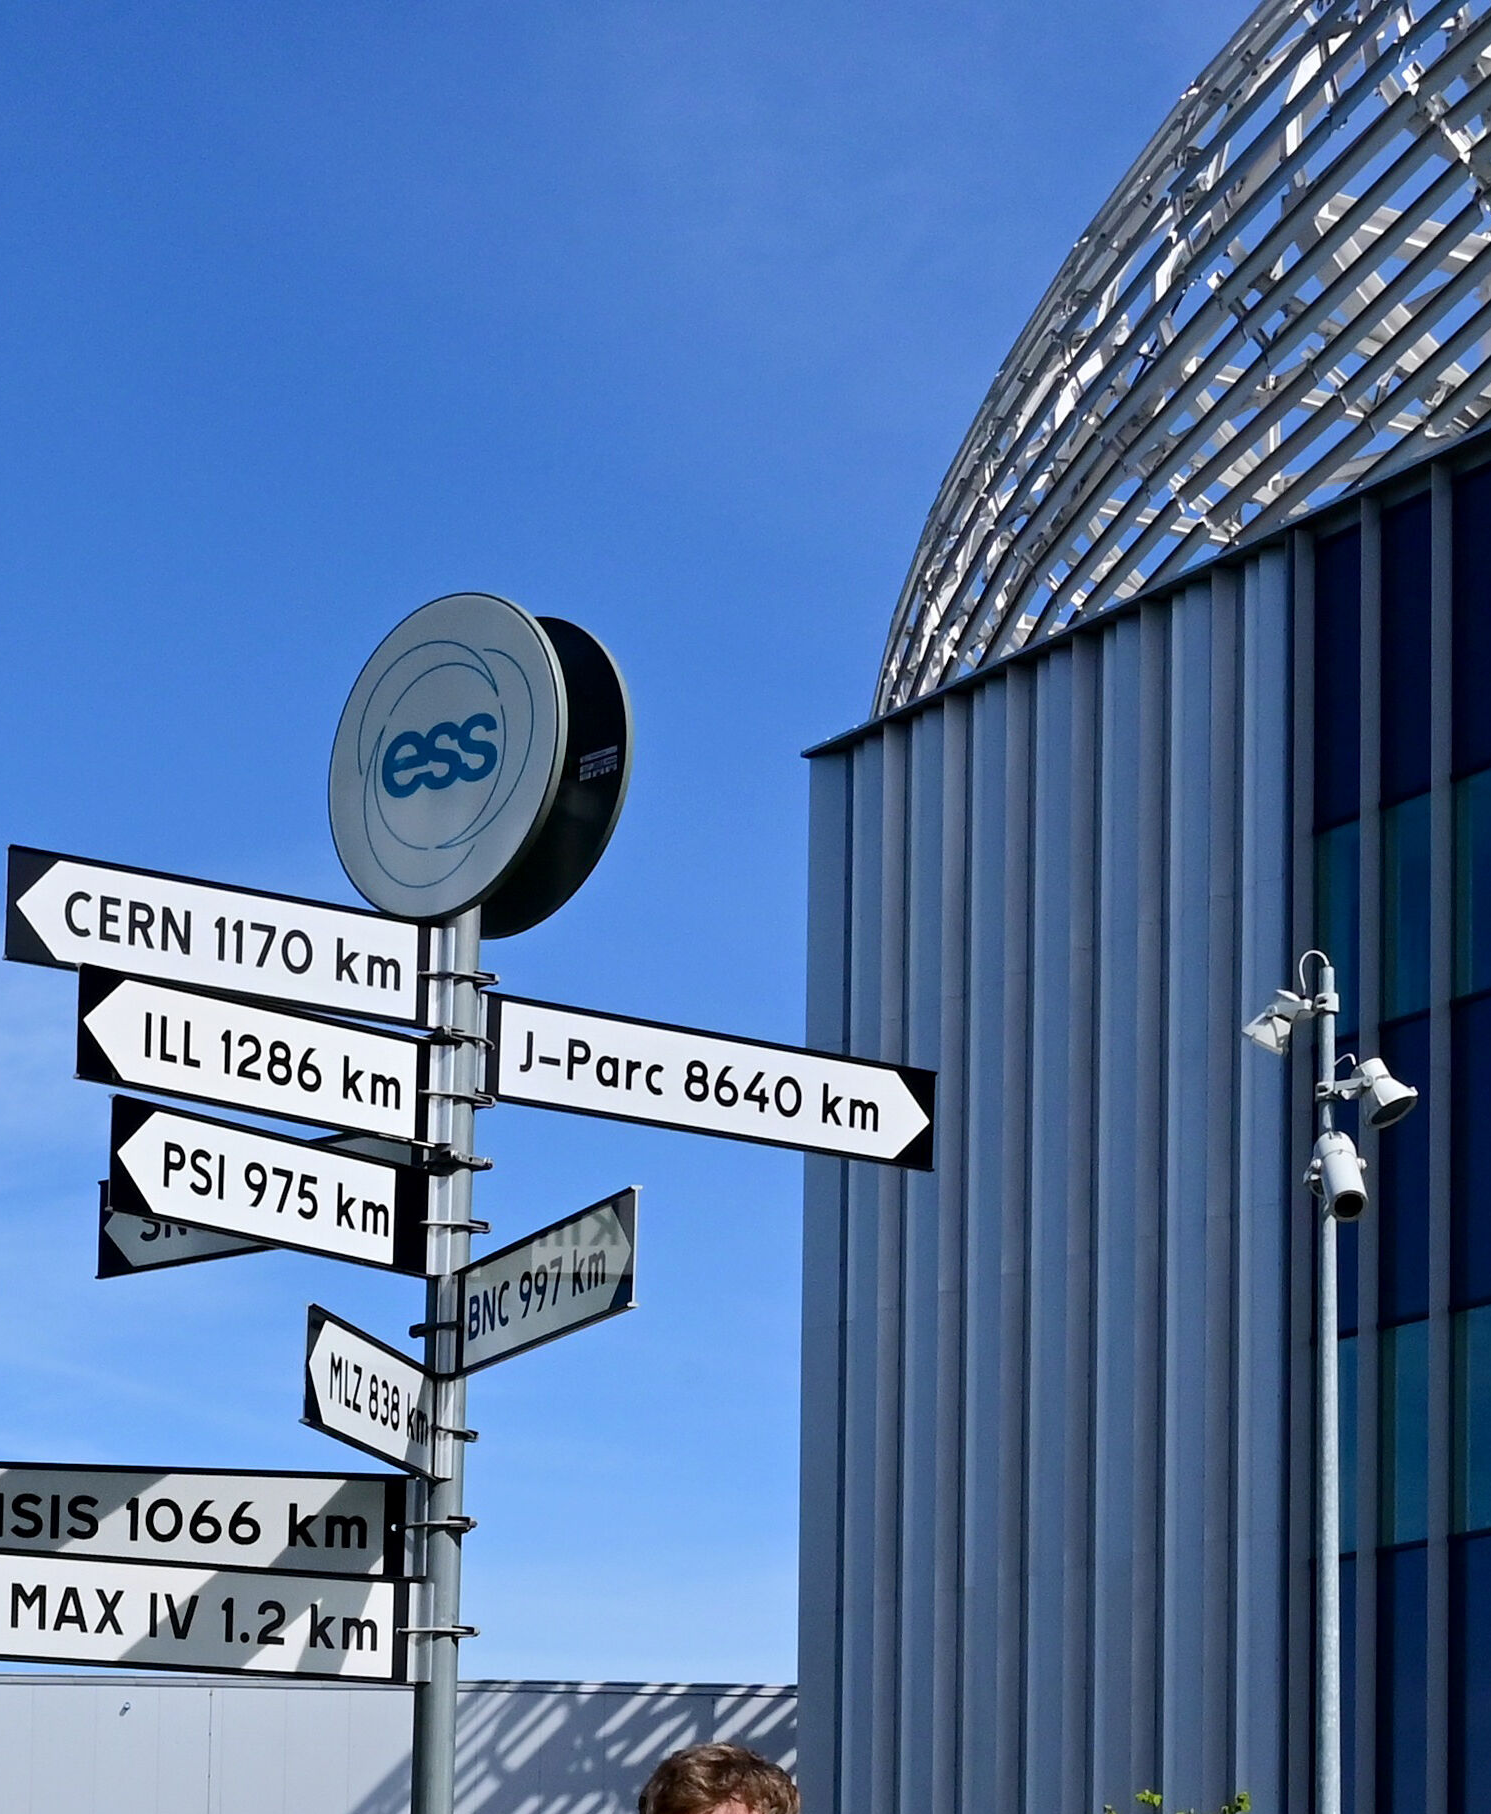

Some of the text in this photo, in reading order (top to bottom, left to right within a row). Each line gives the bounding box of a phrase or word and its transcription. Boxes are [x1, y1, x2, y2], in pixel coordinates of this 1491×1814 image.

[382, 712, 498, 798] ess
[65, 891, 401, 992] CERN 1170 km
[144, 1012, 401, 1110] ILL 1286 km
[519, 1031, 879, 1133] J-Parc 8640 km
[163, 1141, 390, 1238] PSI 975 km
[467, 1248, 607, 1342] BNC 997 km
[329, 1352, 429, 1447] MLZ 838 km
[125, 1496, 261, 1546] 1066
[287, 1502, 369, 1550] km
[10, 1583, 378, 1652] MAX IV 1.2 km
